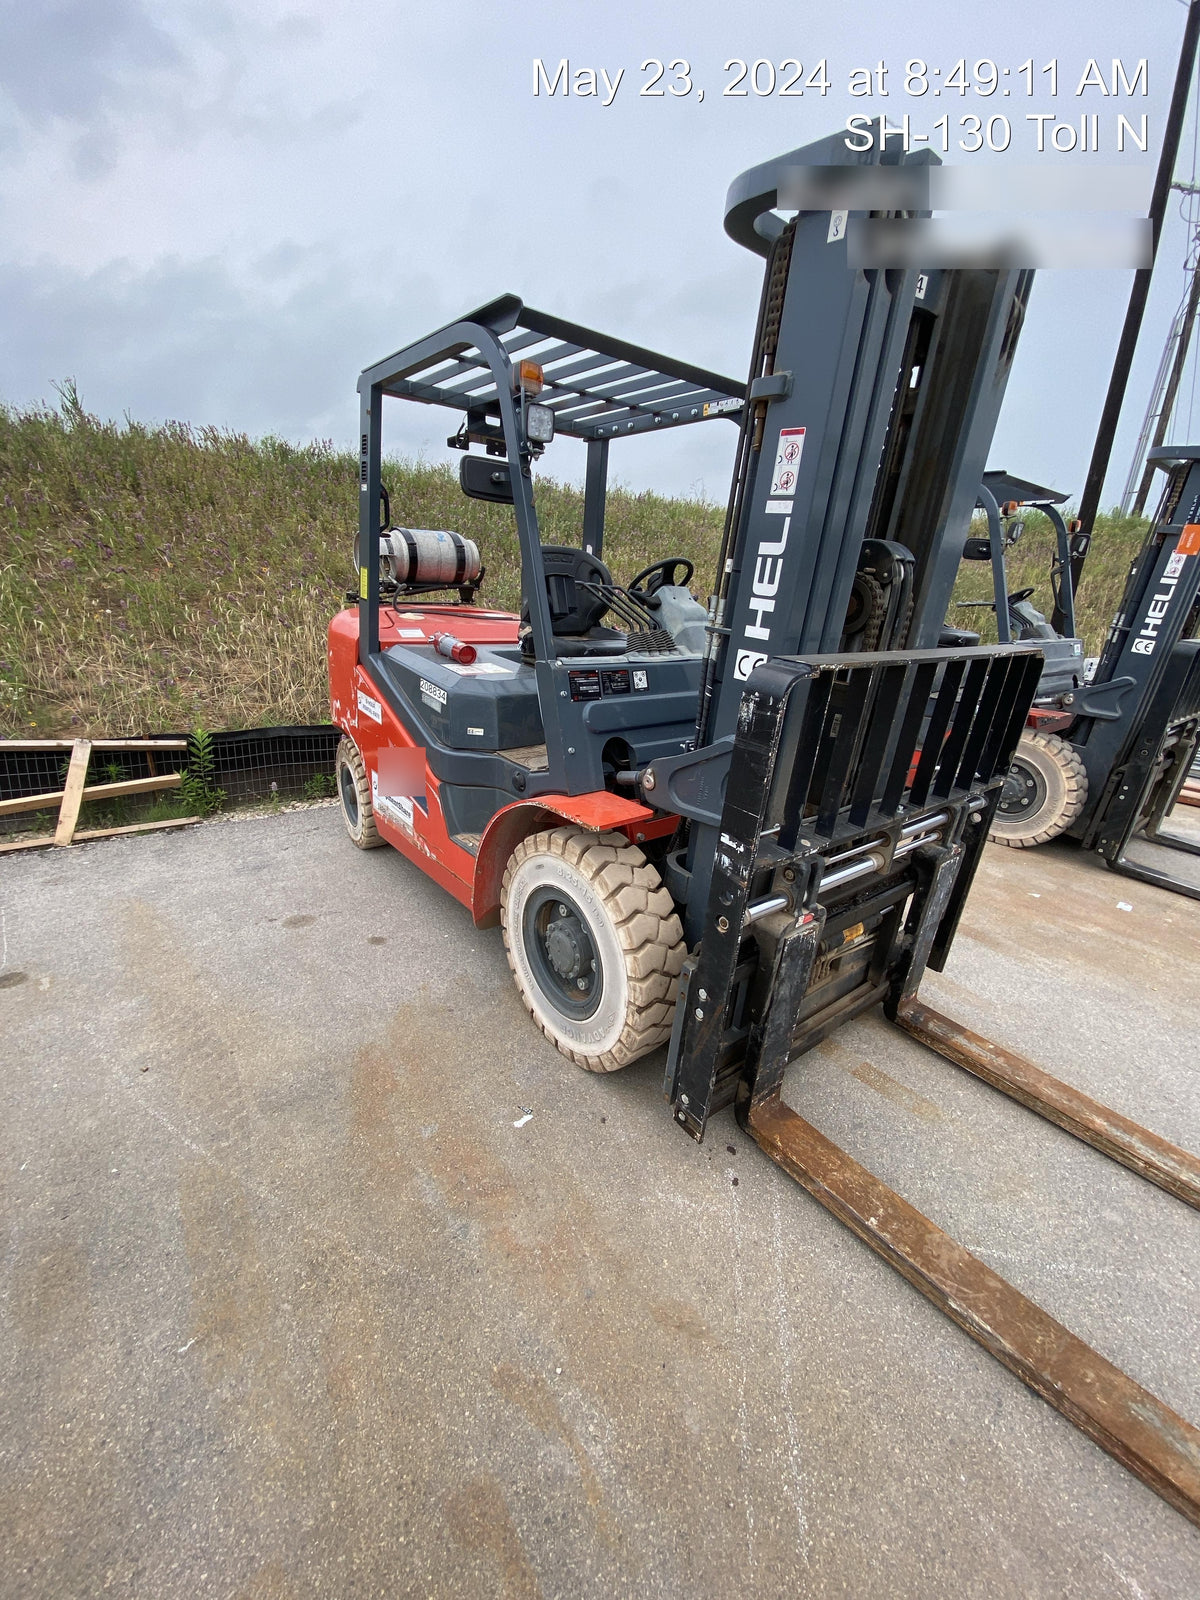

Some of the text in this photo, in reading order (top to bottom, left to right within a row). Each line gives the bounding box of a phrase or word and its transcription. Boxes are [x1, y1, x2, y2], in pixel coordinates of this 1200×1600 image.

[744, 500, 794, 640] HELI
[1139, 576, 1178, 637] HELI
[420, 679, 447, 702] 208834
